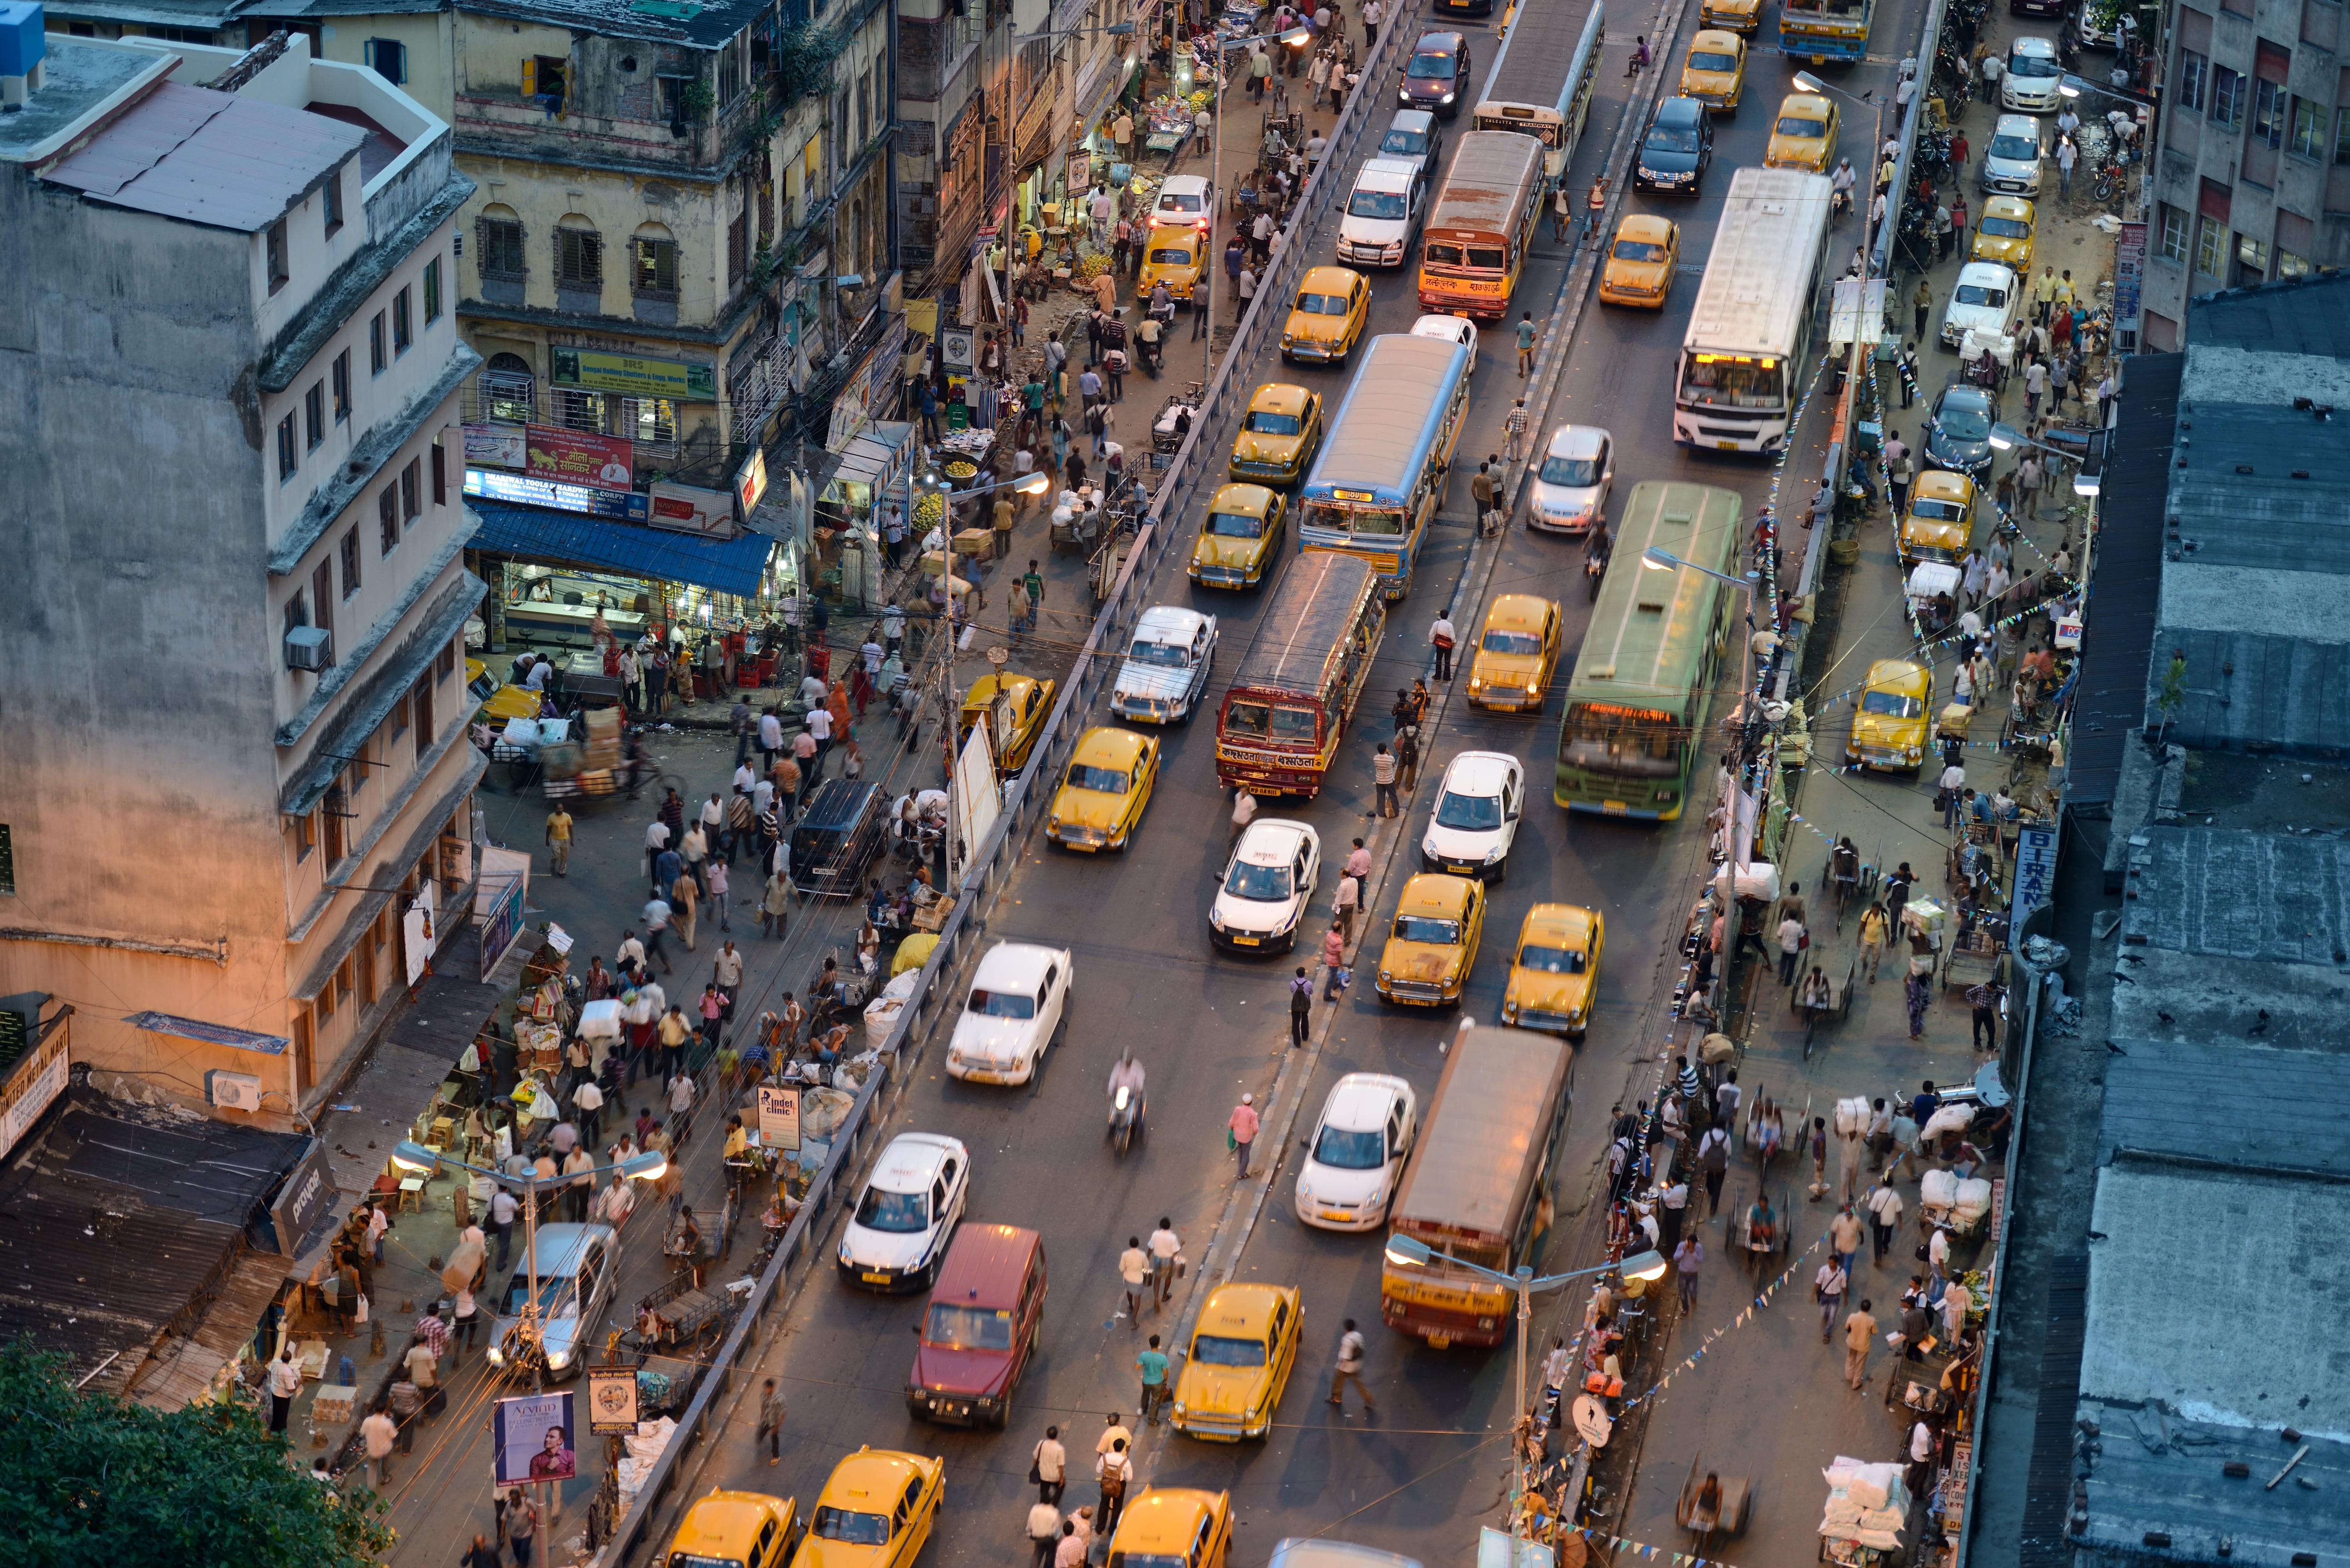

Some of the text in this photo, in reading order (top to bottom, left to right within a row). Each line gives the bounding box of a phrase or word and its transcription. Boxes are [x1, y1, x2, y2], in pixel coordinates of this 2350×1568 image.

[583, 365, 602, 374] Bengal
[603, 367, 622, 376] Rolling
[623, 370, 647, 379] Shutters
[652, 374, 666, 382] Engg.
[569, 448, 588, 463] भोला
[560, 456, 590, 474] सोनकर
[485, 473, 524, 485] DHARIWAL
[525, 479, 548, 490] TOOLS
[600, 491, 625, 500] CORPN
[529, 499, 556, 509] KOLKATA
[584, 493, 606, 502] CUTTING
[657, 501, 692, 514] NAVY CUT
[2023, 832, 2051, 911] BIRAN
[158, 1022, 239, 1044] ENTERPRISE
[0, 1080, 25, 1117] UNITED
[27, 1053, 47, 1089] METAL
[50, 1030, 67, 1063] MART
[767, 1104, 791, 1116] clinic
[771, 1097, 793, 1109] indef
[509, 1418, 536, 1427] FALLING
